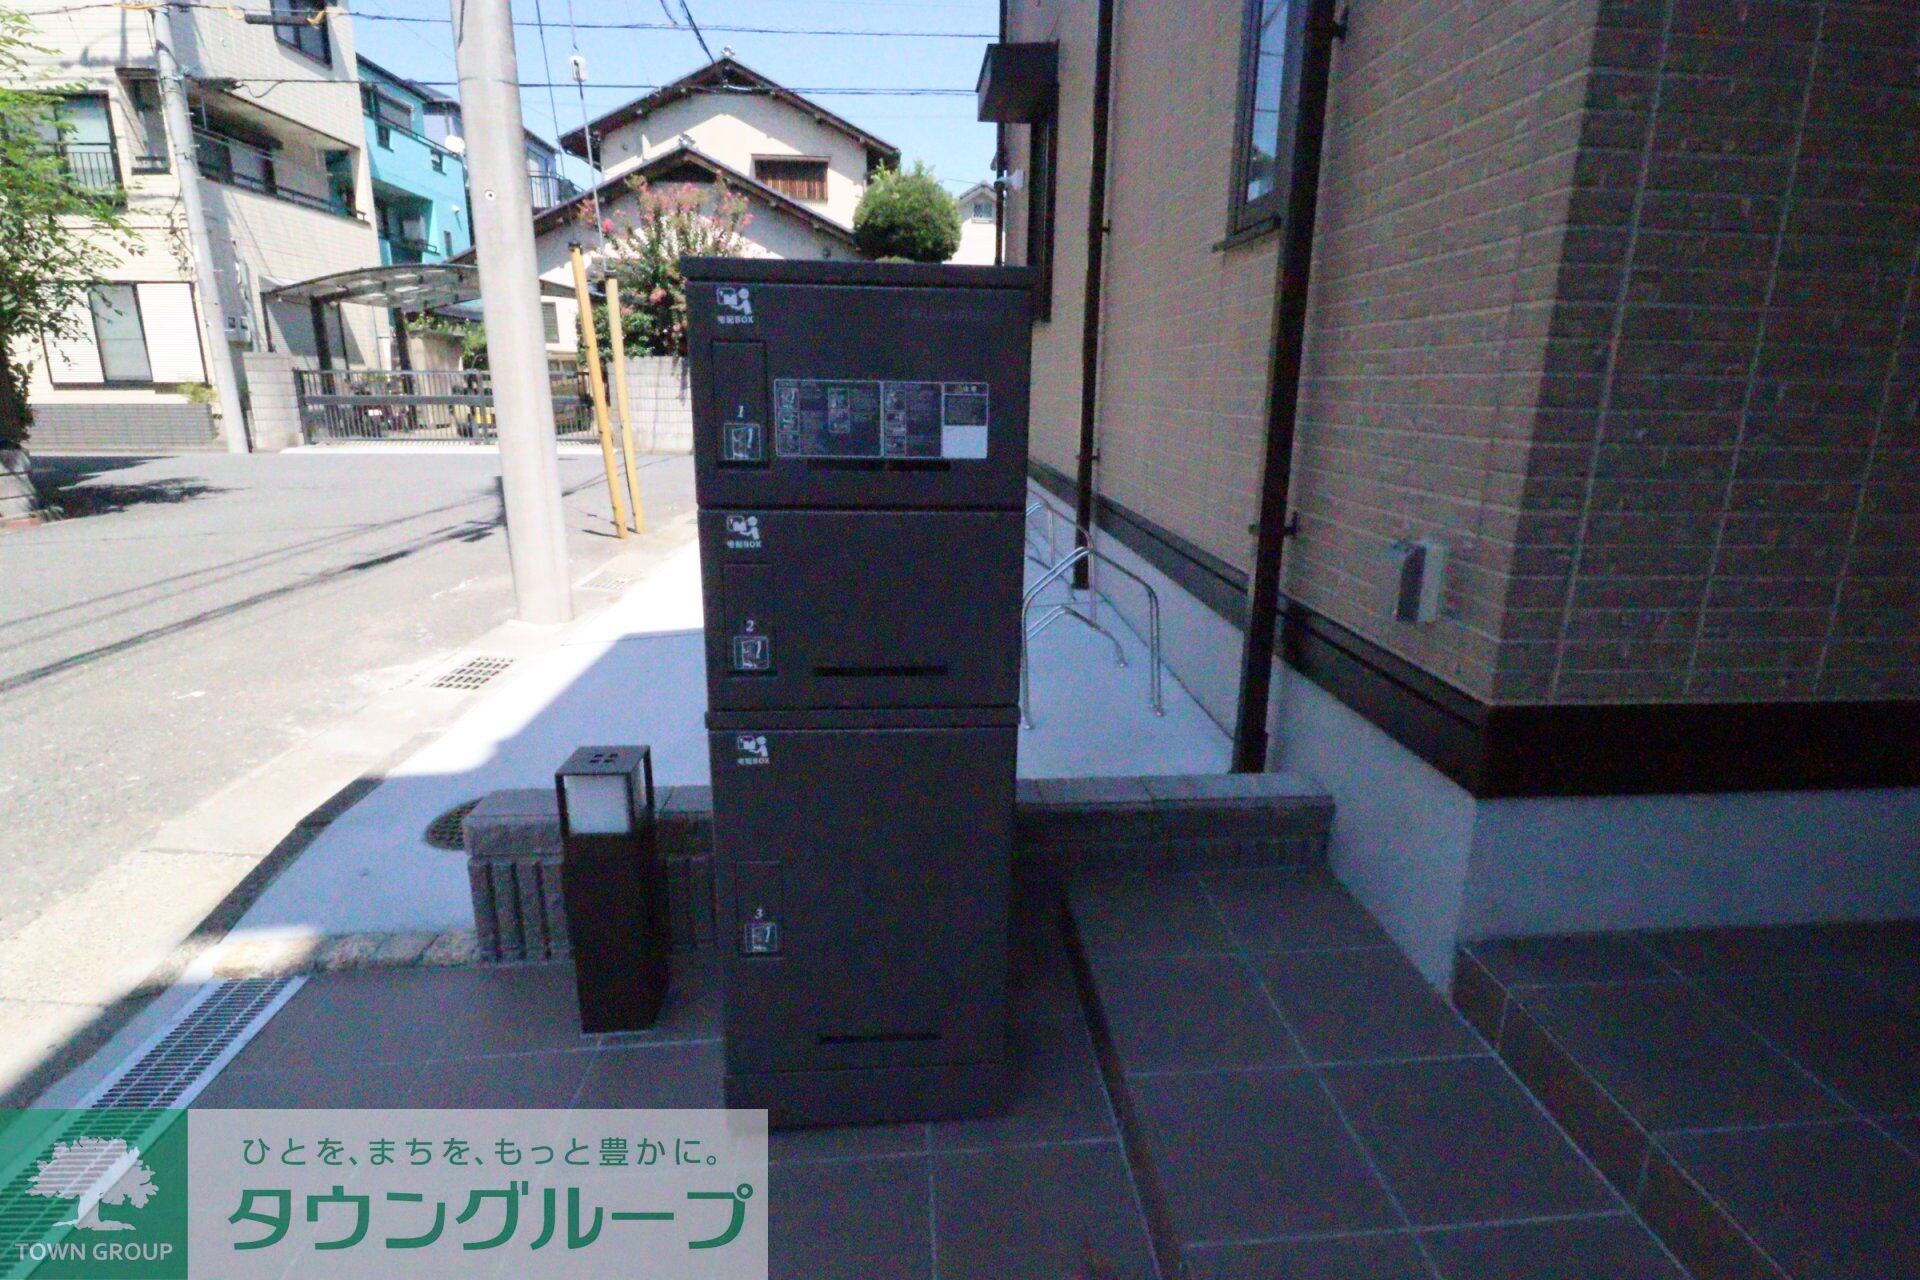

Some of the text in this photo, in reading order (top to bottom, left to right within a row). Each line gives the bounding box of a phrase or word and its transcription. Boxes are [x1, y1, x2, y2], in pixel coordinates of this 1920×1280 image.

[737, 405, 744, 418] 1
[745, 619, 755, 632] 2
[754, 908, 763, 919] 3
